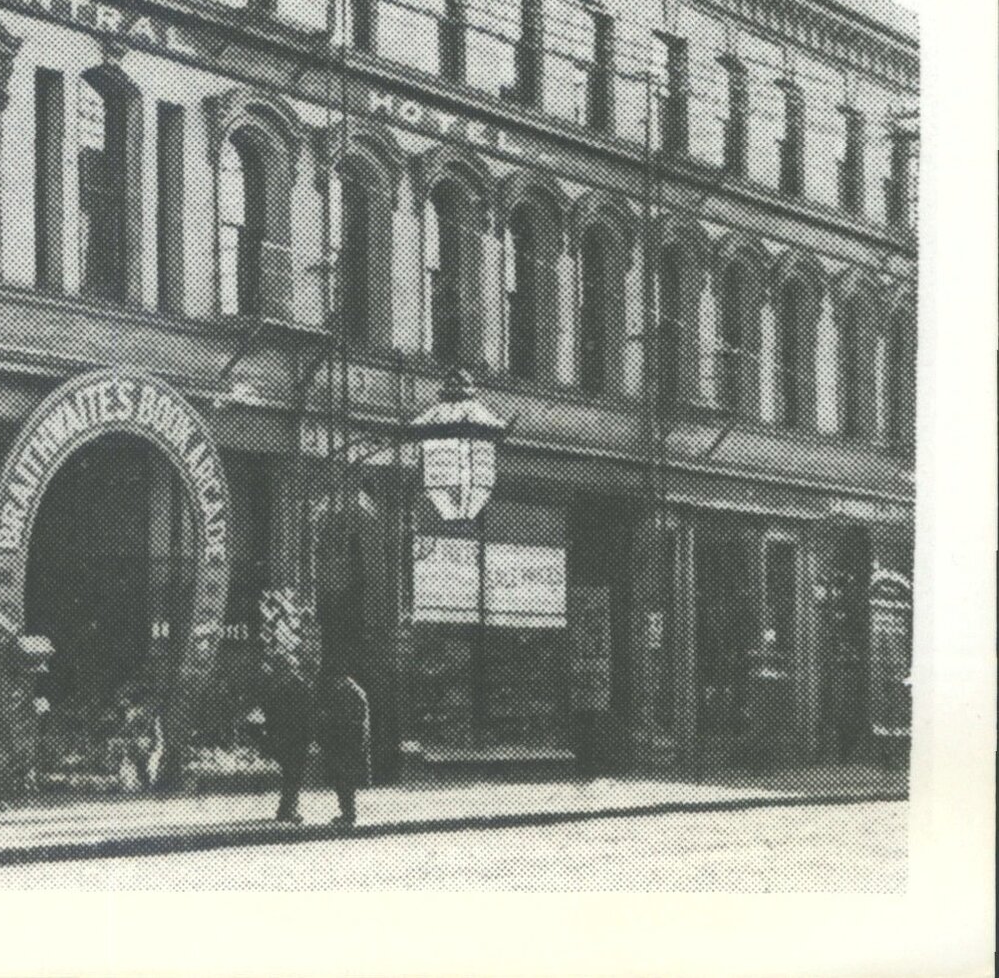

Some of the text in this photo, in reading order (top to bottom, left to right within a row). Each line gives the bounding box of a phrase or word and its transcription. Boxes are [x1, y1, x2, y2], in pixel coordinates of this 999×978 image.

[367, 89, 523, 155] HOTEL
[136, 384, 199, 458] BOOK
[184, 440, 227, 564] ARCADE
